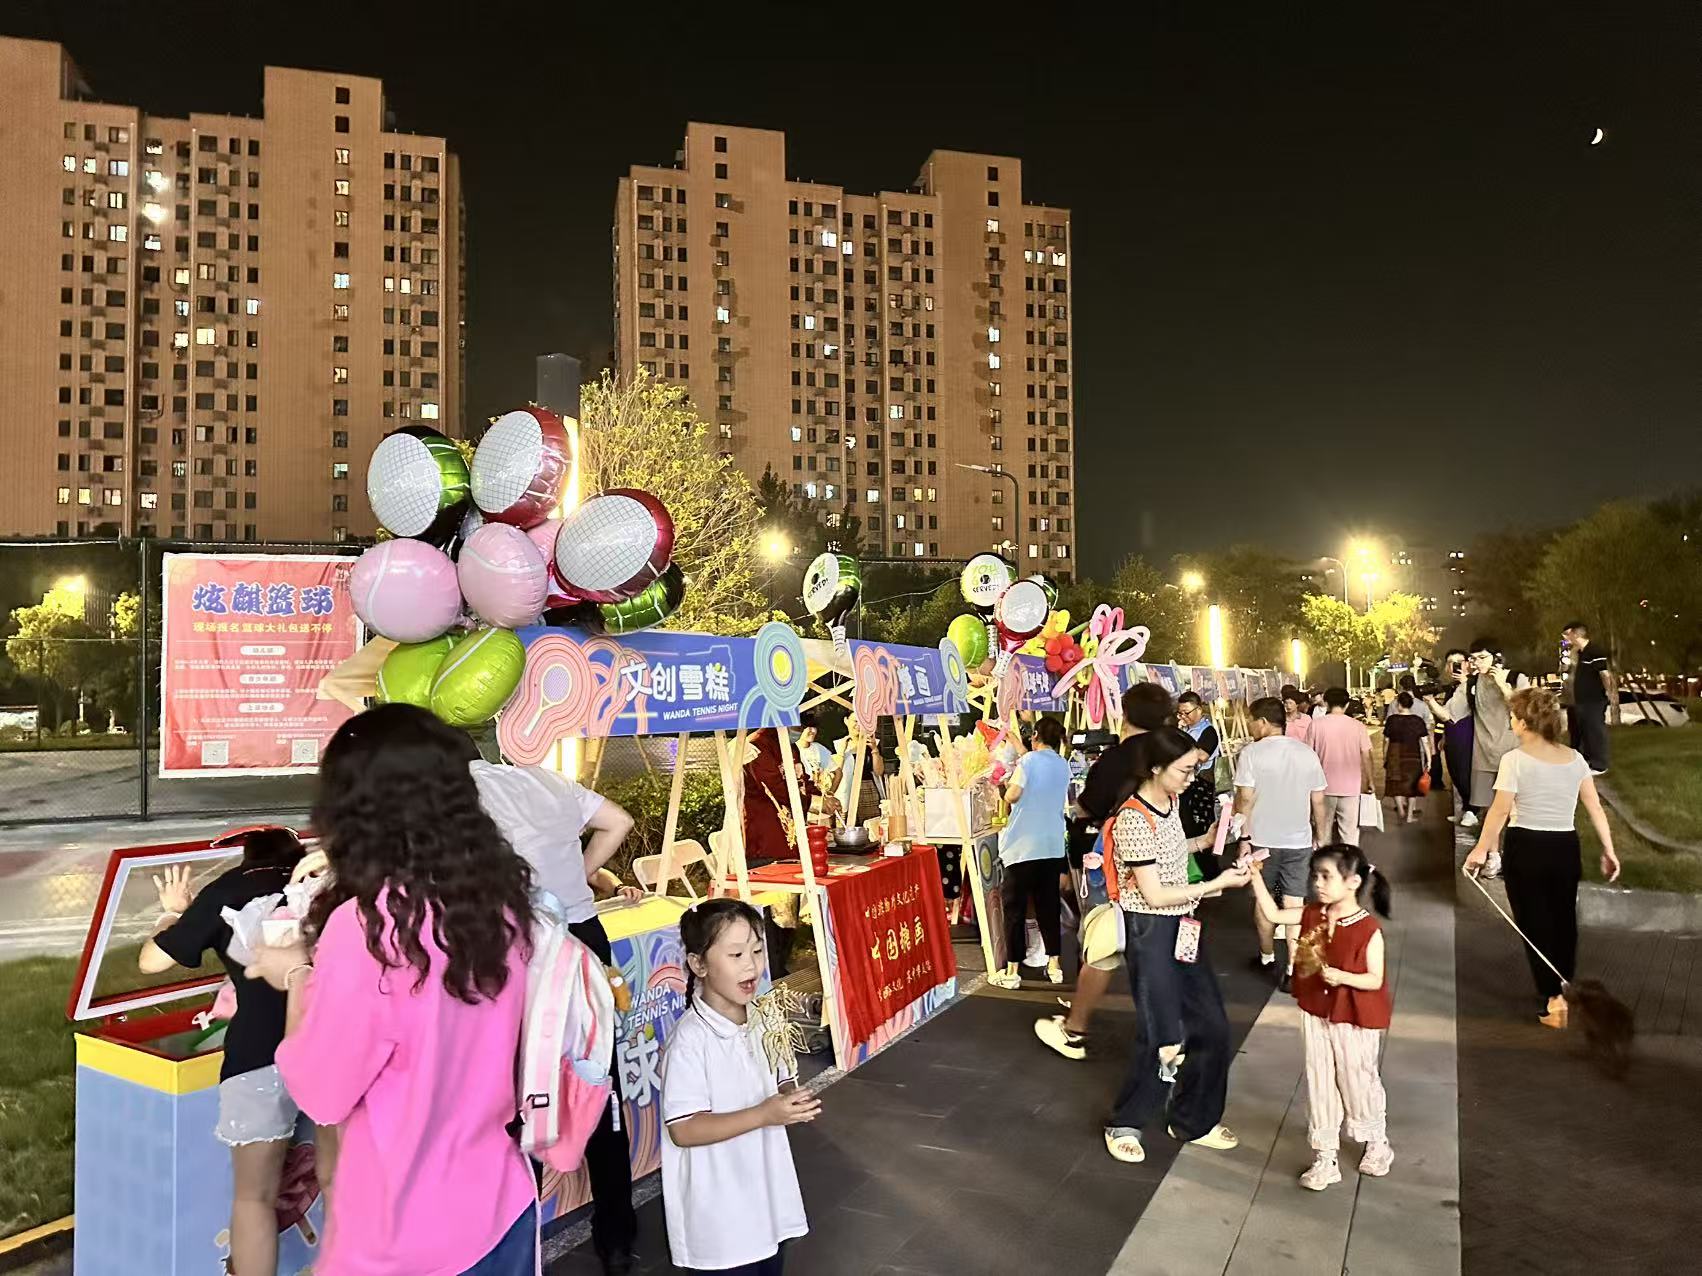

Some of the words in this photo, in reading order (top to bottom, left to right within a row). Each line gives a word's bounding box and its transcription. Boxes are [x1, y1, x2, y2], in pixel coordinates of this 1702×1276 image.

[620, 660, 730, 702] 文创雪糕
[663, 708, 690, 720] WANDA
[692, 705, 717, 716] TENNIS
[718, 702, 739, 713] NIGHT
[630, 982, 671, 1008] WANDA
[627, 1001, 669, 1031] TENNIS
